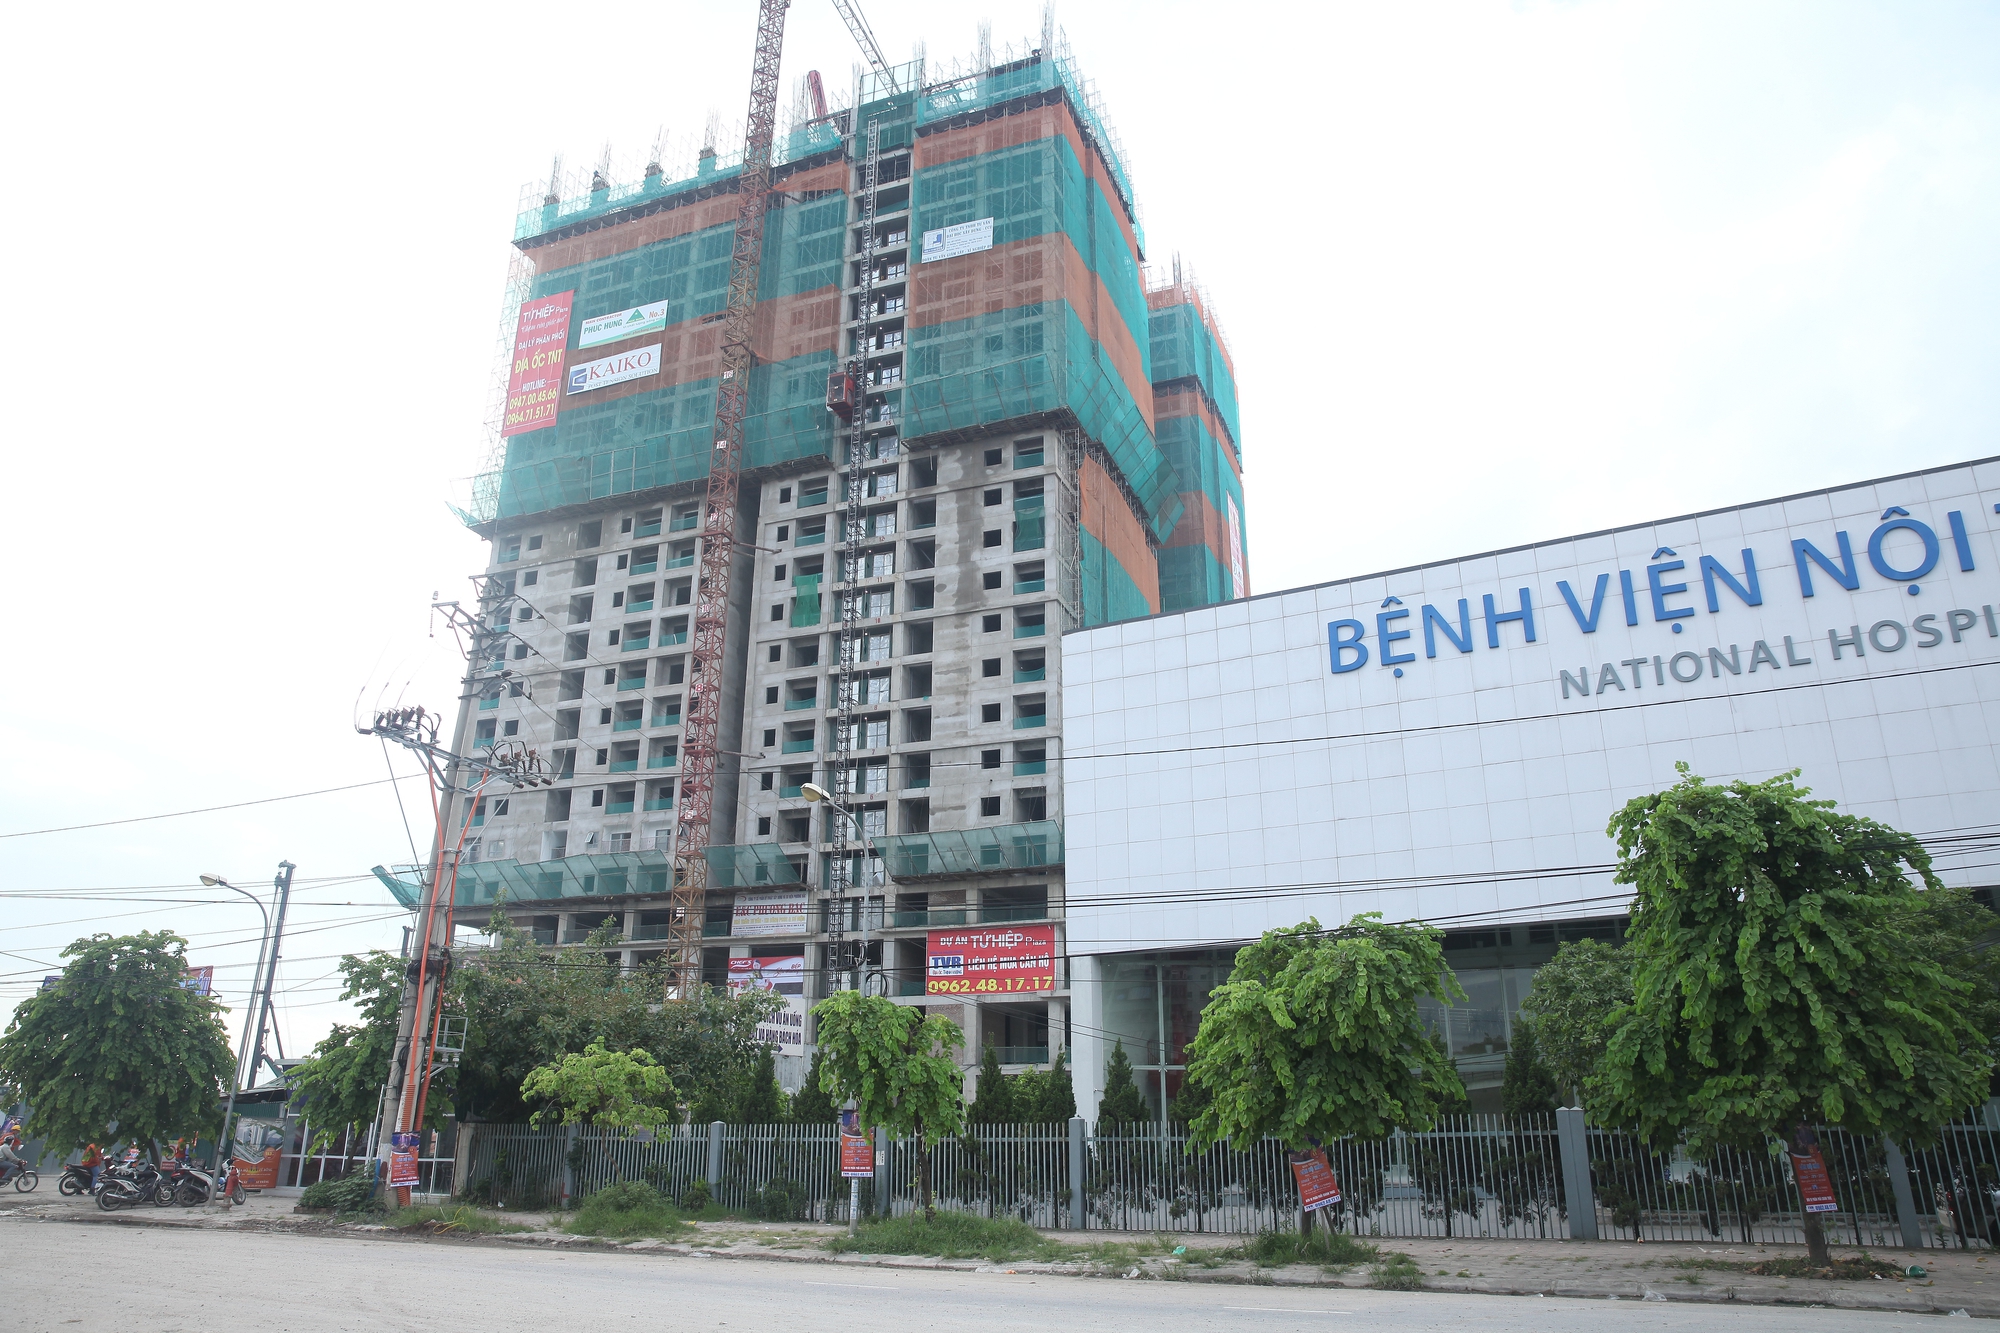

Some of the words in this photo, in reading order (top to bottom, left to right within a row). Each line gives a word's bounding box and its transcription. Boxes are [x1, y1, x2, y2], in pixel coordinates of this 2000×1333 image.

[532, 349, 545, 369] ỐC
[548, 349, 563, 365] TNT
[589, 352, 651, 380] KAIKO
[1327, 587, 1537, 678] BỆNH
[1556, 546, 1763, 634] VIỆN
[1791, 506, 1975, 598] NỘI
[1558, 634, 1812, 700] NATIONAL
[1828, 604, 2000, 660] HOSPI
[940, 936, 953, 947] DỰ
[955, 935, 968, 945] ÁN
[968, 956, 985, 971] LIÊN
[987, 955, 998, 972] HỆ
[1000, 956, 1017, 970] MUA
[1020, 953, 1036, 968] CĂN
[1038, 952, 1049, 970] HỘ
[928, 976, 1052, 993] 0962.48.17.17
